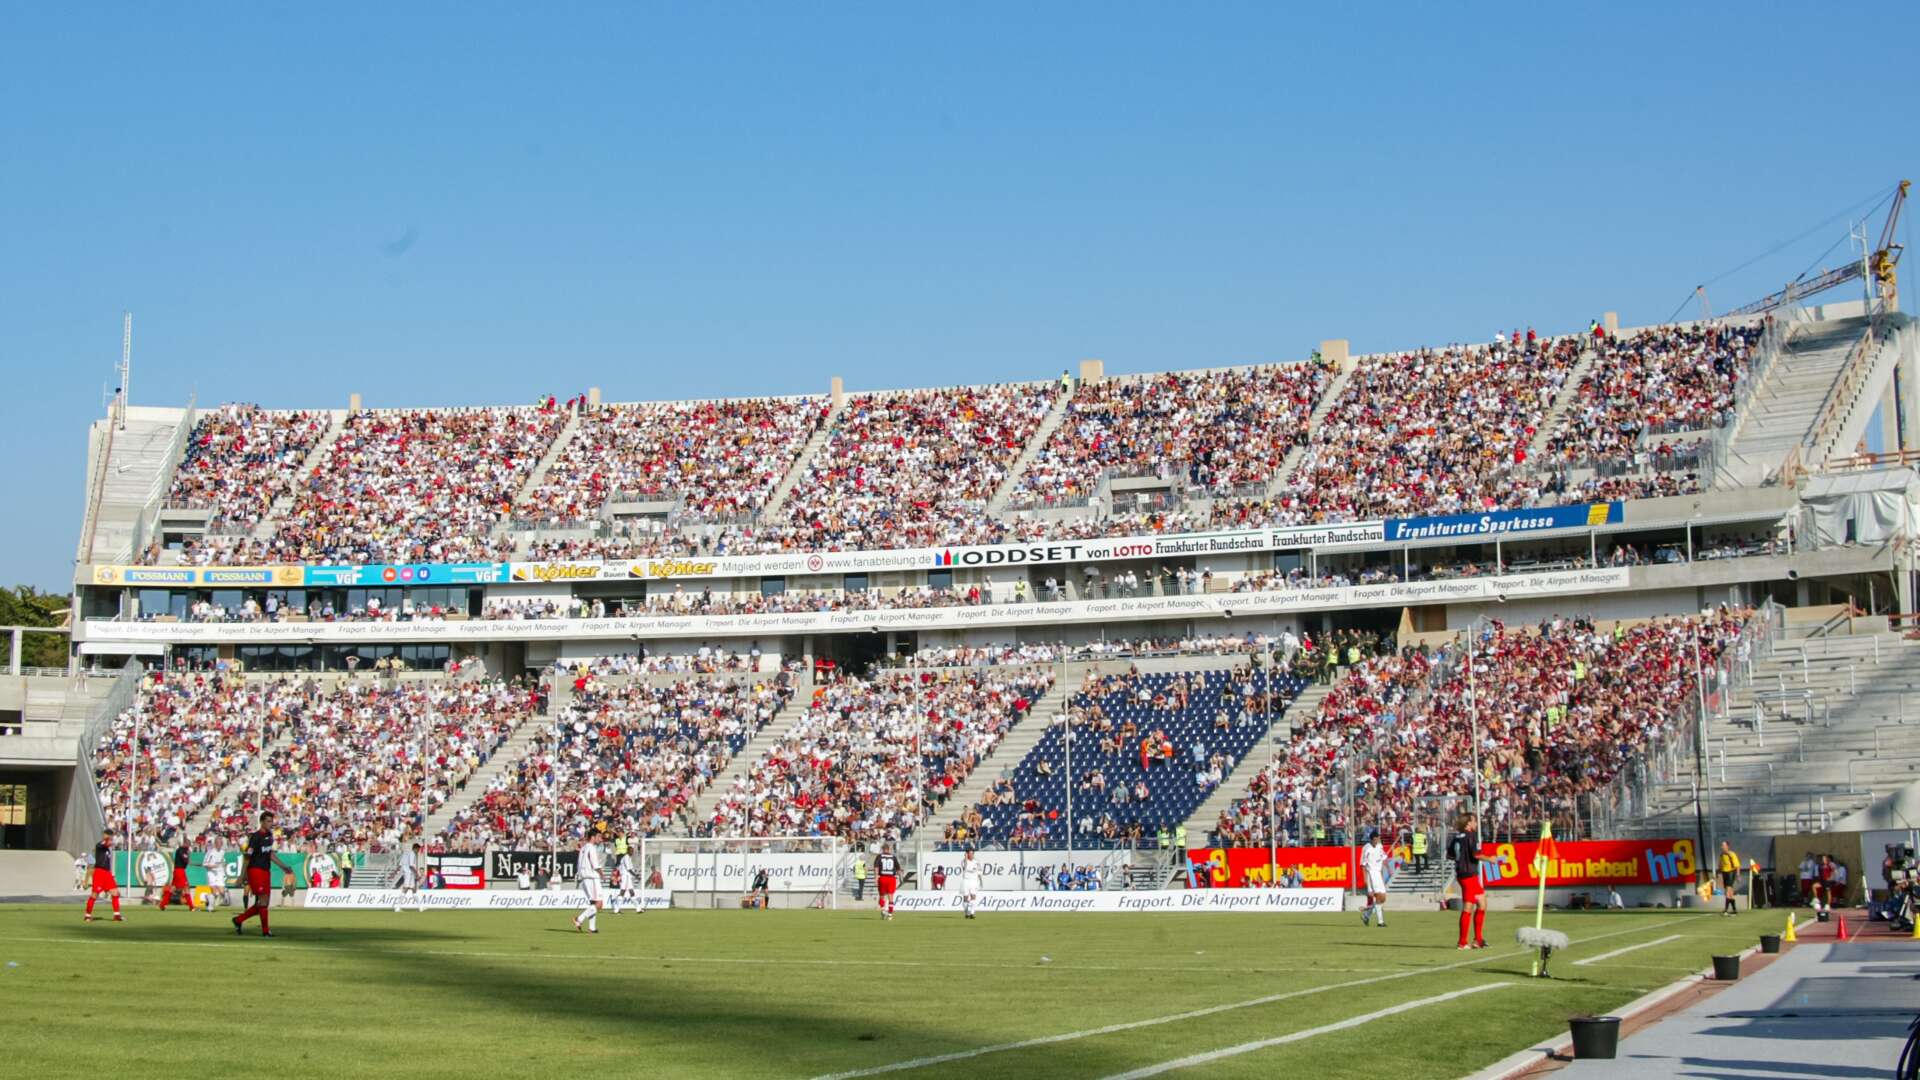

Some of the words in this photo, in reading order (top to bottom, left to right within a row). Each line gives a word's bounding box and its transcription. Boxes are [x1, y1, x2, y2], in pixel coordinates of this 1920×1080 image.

[1396, 521, 1477, 539] Frankfurter
[1479, 515, 1553, 534] Sparkasse
[1156, 540, 1208, 554] Frankfurter
[1210, 535, 1264, 550] Rundschau
[1273, 533, 1326, 547] Frankfurter
[1327, 529, 1383, 544] Rundschau
[962, 545, 1083, 565] ODDSET
[1087, 548, 1110, 558] von
[1113, 544, 1152, 557] LOTTO
[336, 566, 363, 584] VGF
[475, 564, 503, 582] VGF
[724, 864, 744, 876] Die
[881, 858, 894, 870] 10
[983, 863, 1004, 876] Die
[1528, 858, 1558, 878] vll
[1561, 858, 1584, 878] im
[1586, 857, 1638, 878] leben!
[1646, 839, 1694, 883] hr3
[357, 893, 374, 904] Die
[539, 895, 559, 906] Die
[562, 894, 591, 909] Airp
[979, 895, 1028, 911] Airport
[1031, 895, 1096, 912] Manager.
[1118, 895, 1175, 912] Fraport.
[1182, 894, 1202, 906] Die
[1209, 894, 1260, 910] Airport
[1266, 893, 1335, 910] Manager.
